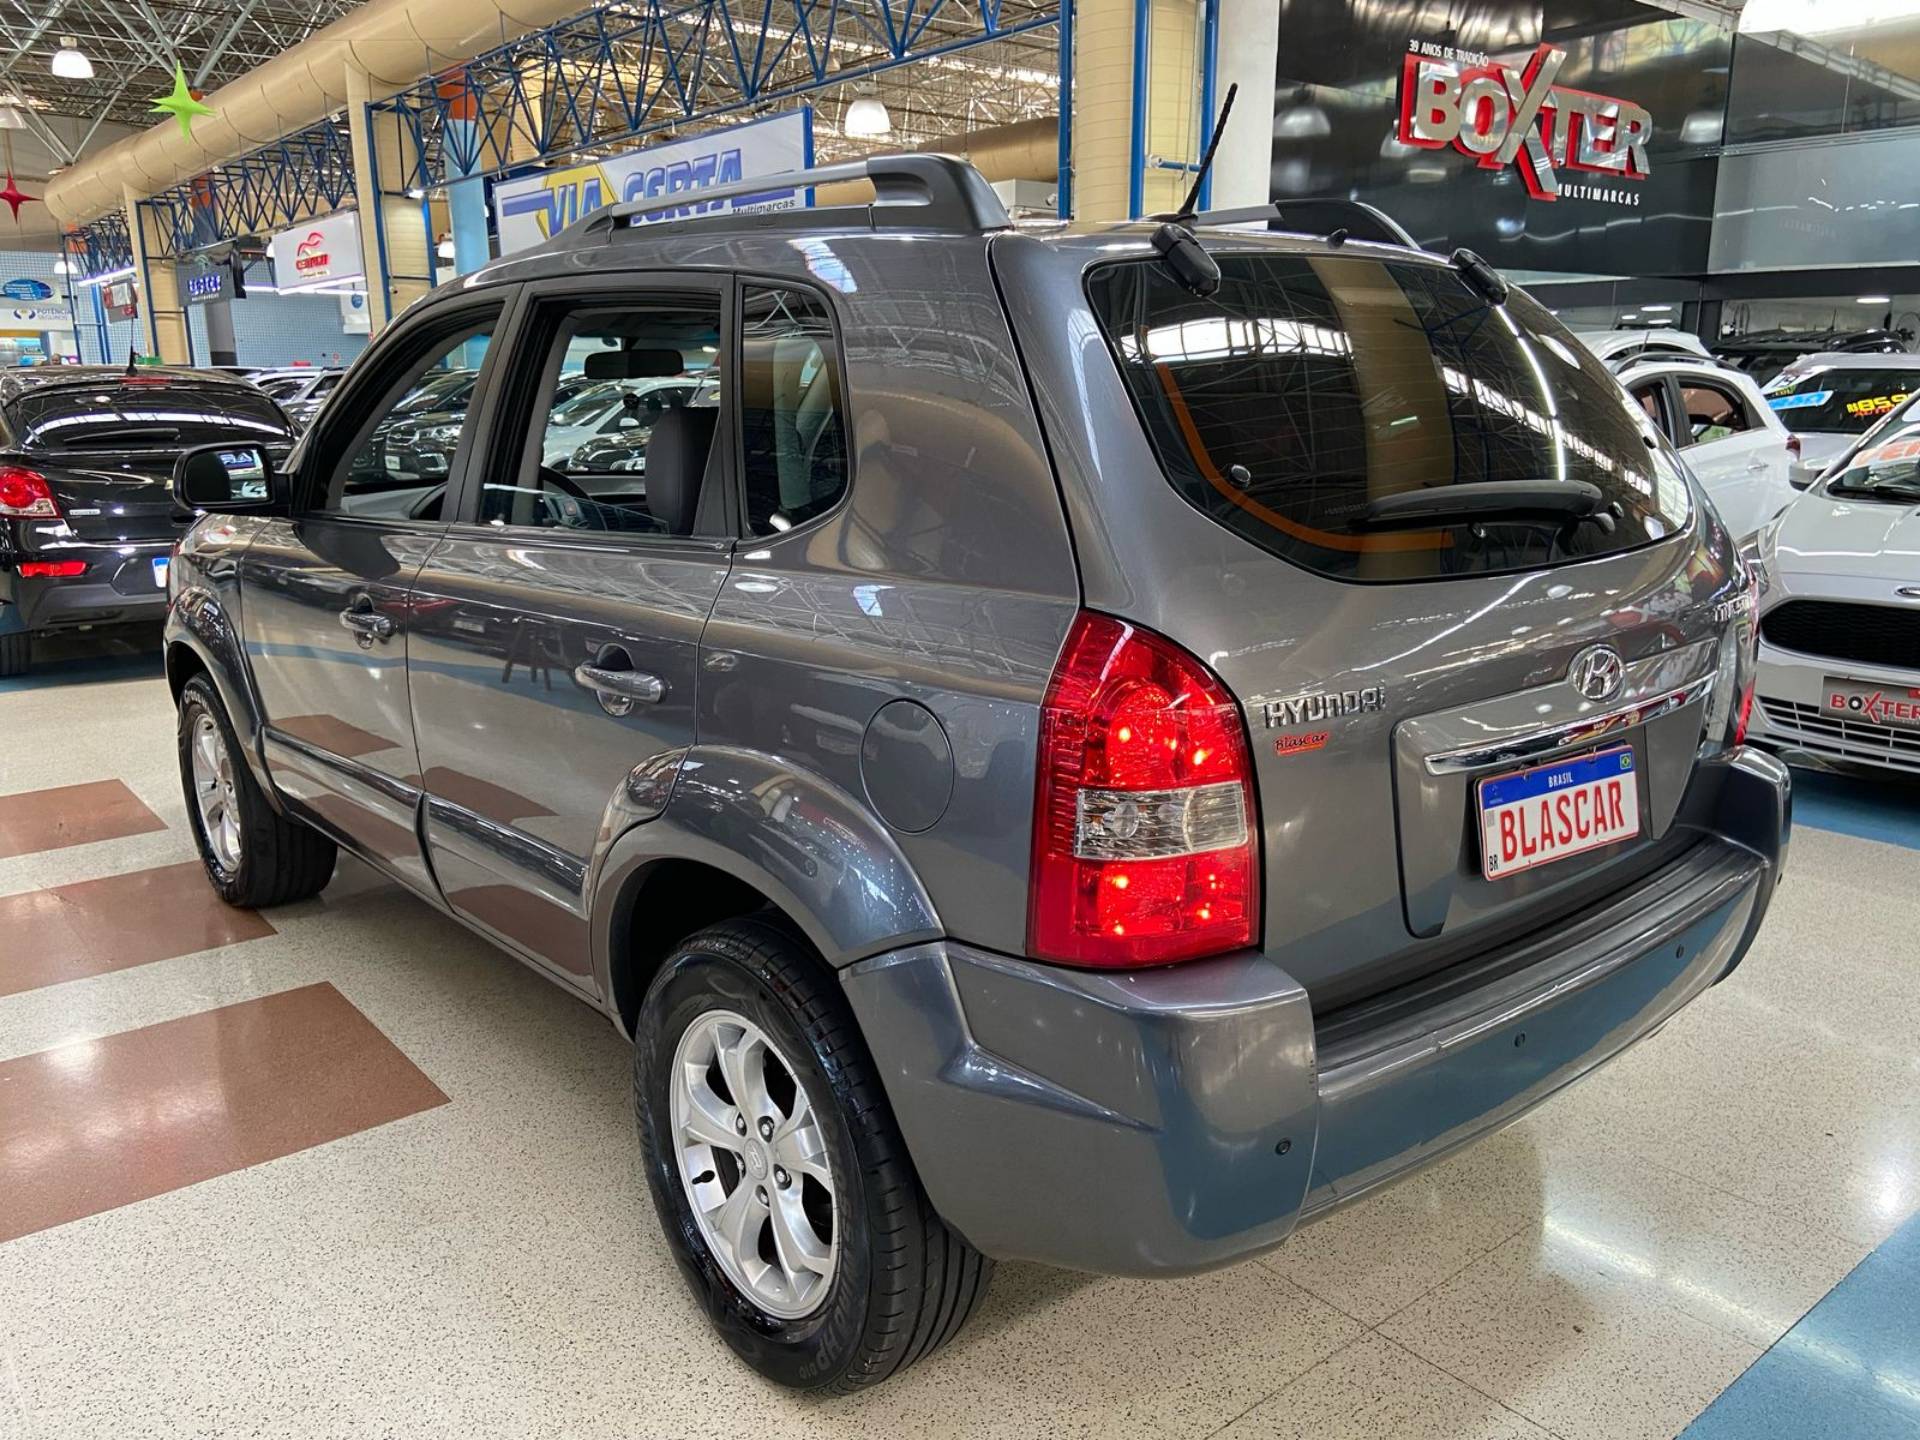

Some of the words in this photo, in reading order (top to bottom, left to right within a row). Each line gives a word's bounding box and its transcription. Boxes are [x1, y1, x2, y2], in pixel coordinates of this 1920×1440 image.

[1408, 39, 1419, 53] 39
[1421, 42, 1442, 58] ANOS
[1444, 47, 1454, 60] DE
[1456, 49, 1490, 68] TRADIÇÃO
[1401, 45, 1653, 198] BOXTER
[546, 178, 602, 237] VIA
[1263, 679, 1386, 729] HYUNDAI
[1548, 771, 1573, 788] BRASIL
[1500, 780, 1625, 863] BLASCAR
[1488, 854, 1499, 872] BR
